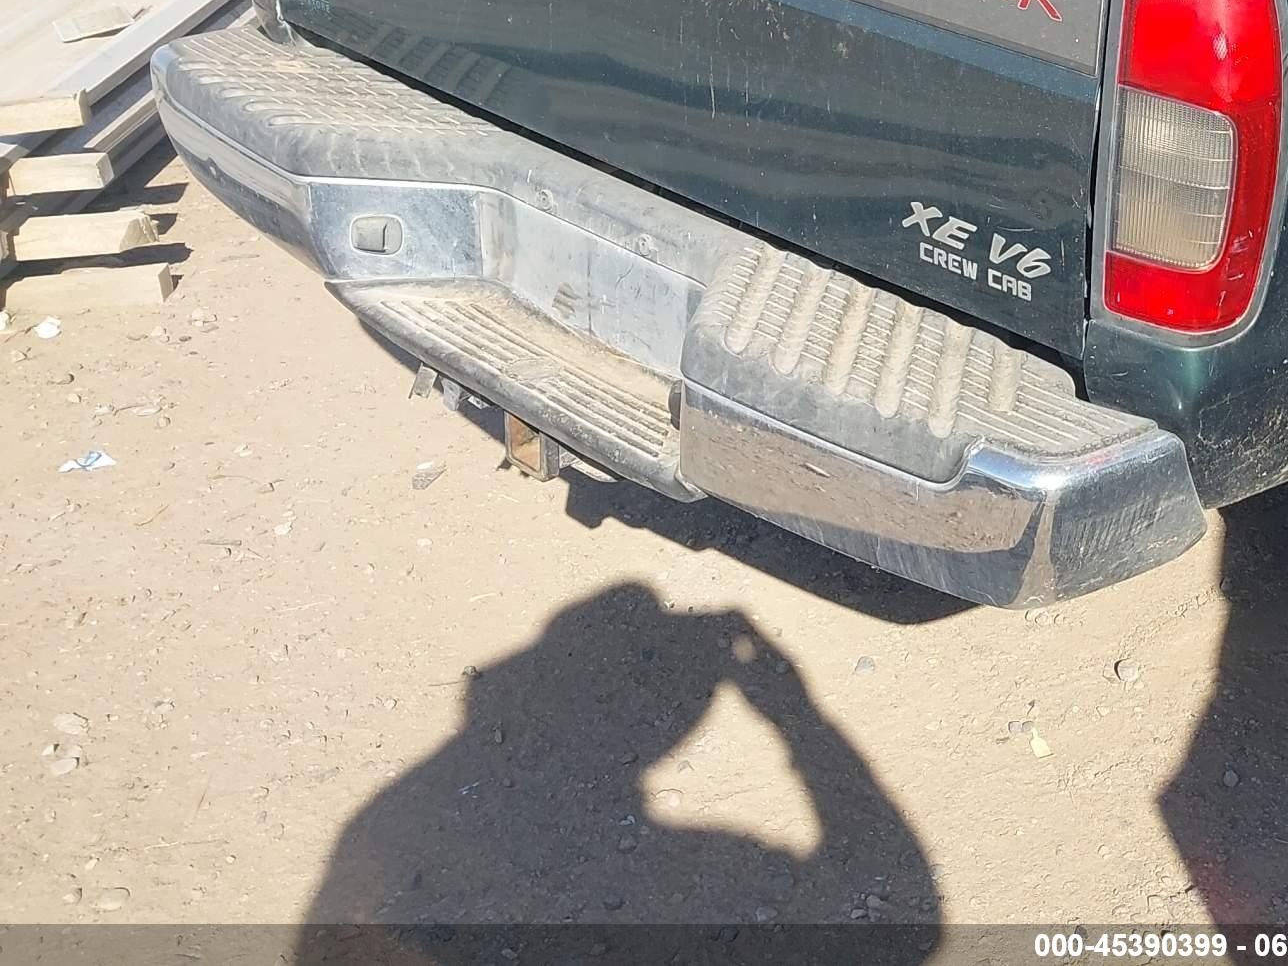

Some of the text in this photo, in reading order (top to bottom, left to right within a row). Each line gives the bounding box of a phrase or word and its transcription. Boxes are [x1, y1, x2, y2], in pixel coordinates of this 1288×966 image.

[902, 202, 1052, 279] XE V6
[919, 242, 1032, 301] CREW CAB
